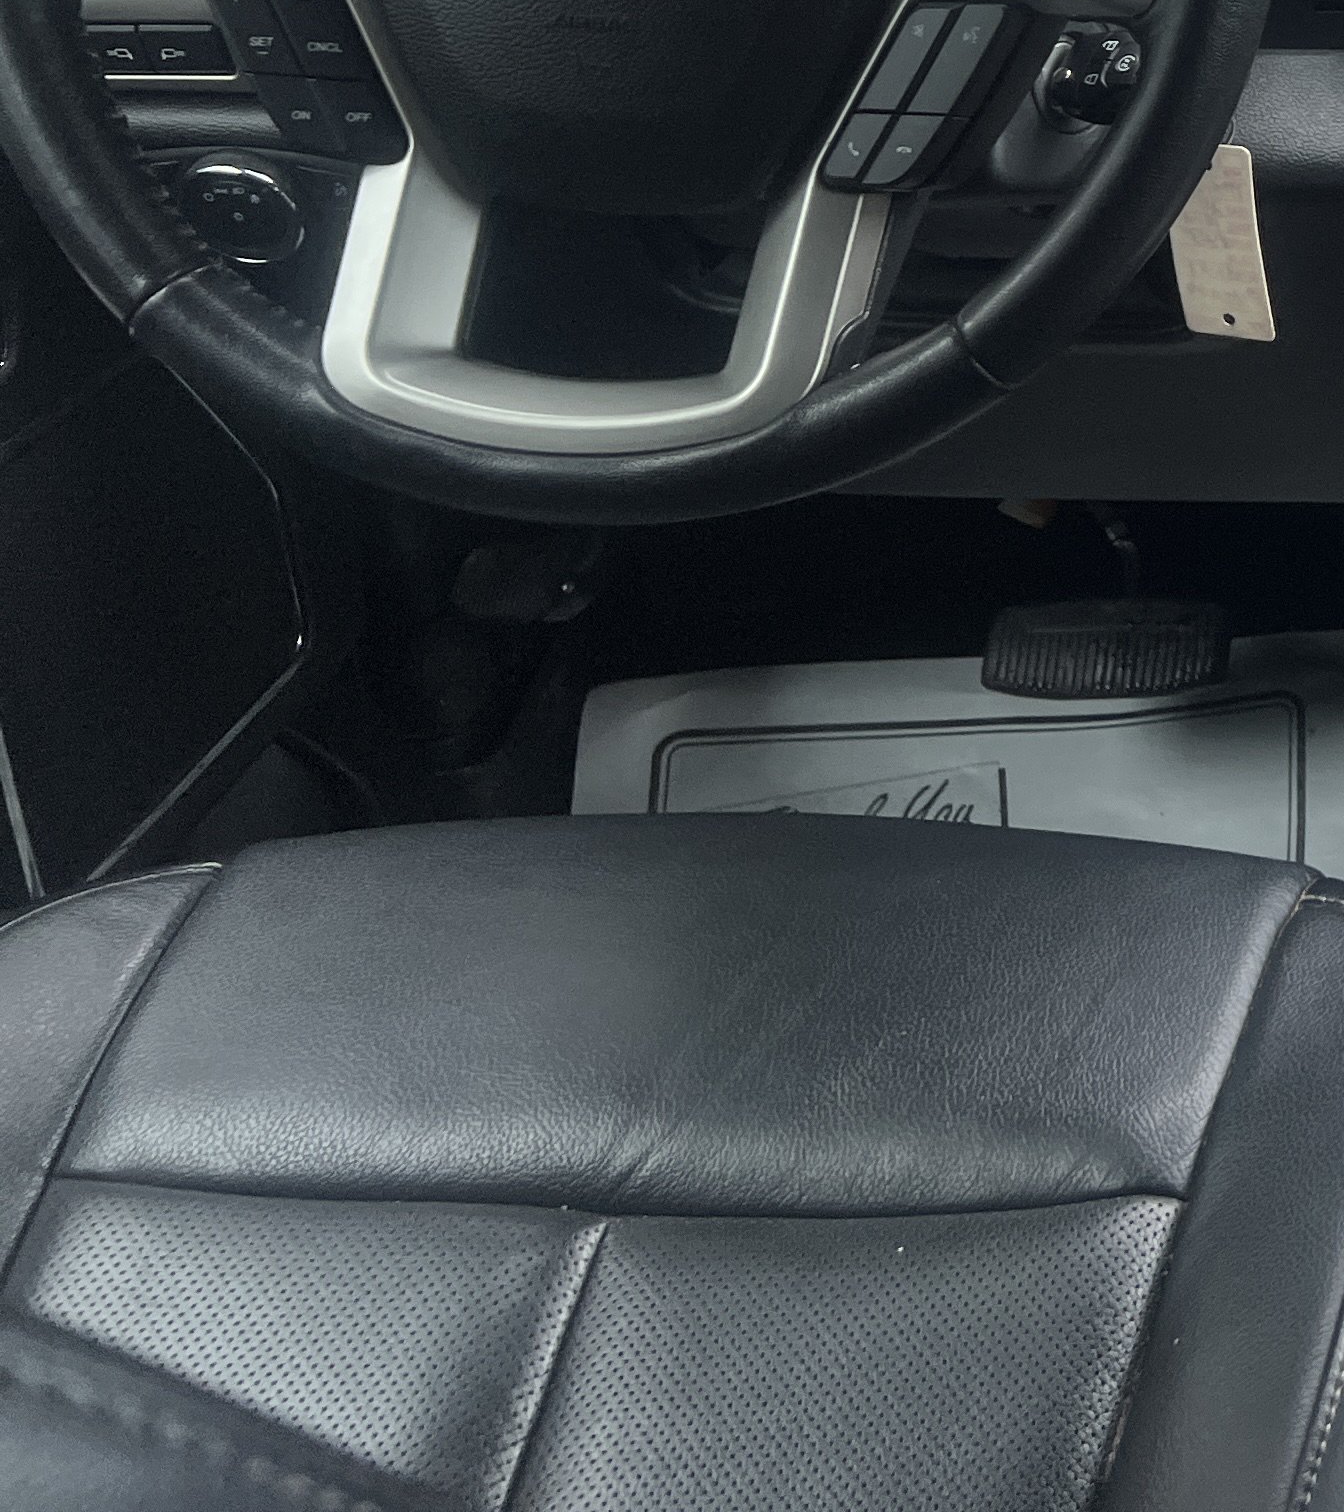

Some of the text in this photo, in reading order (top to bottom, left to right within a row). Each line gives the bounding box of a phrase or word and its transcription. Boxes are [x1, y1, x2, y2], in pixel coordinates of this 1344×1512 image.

[249, 36, 275, 47] SET
[306, 41, 344, 53] CNCL
[290, 109, 312, 121] ON
[345, 111, 373, 123] OFF
